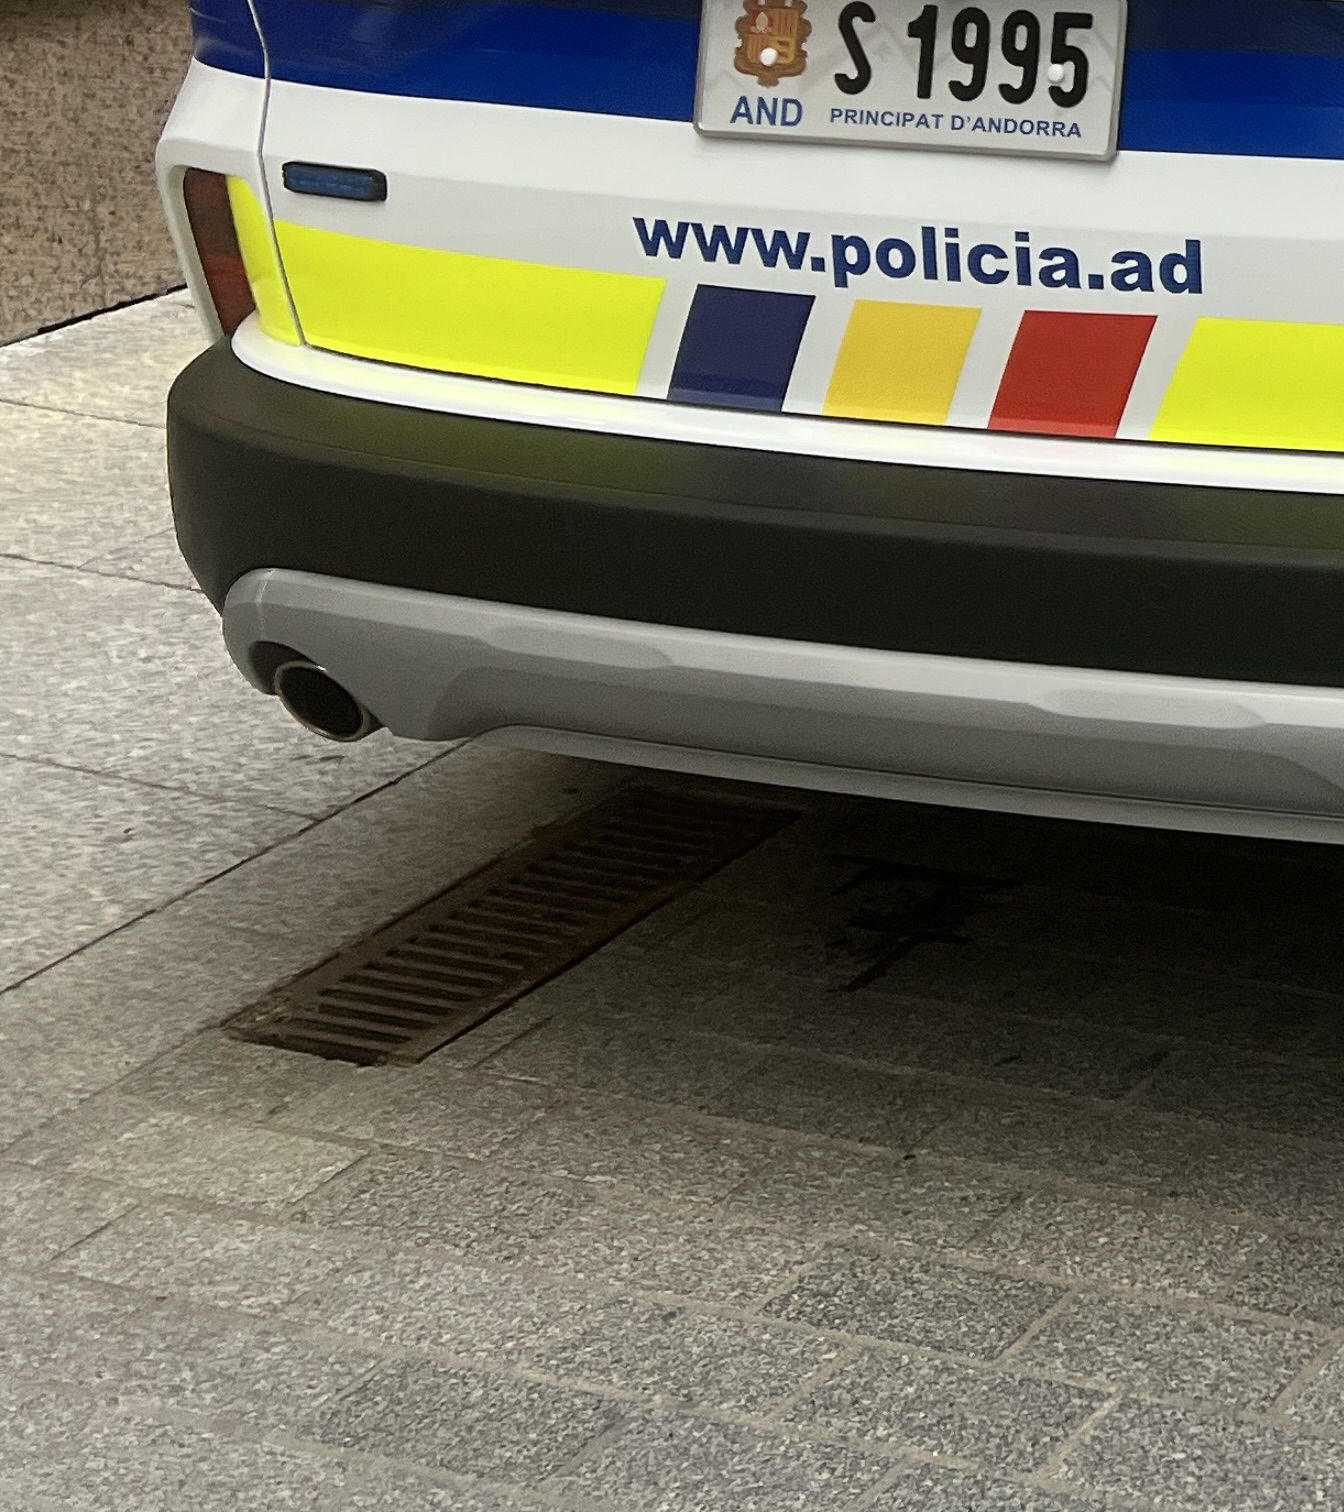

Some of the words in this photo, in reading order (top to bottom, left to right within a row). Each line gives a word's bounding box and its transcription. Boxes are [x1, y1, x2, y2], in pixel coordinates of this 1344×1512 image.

[833, 0, 877, 96] S
[906, 4, 1094, 109] 1995
[730, 95, 804, 128] AND
[829, 107, 944, 131] PRINCIPAT
[949, 115, 1082, 139] D'ANDORRA
[632, 217, 1204, 295] www.policia.ad
